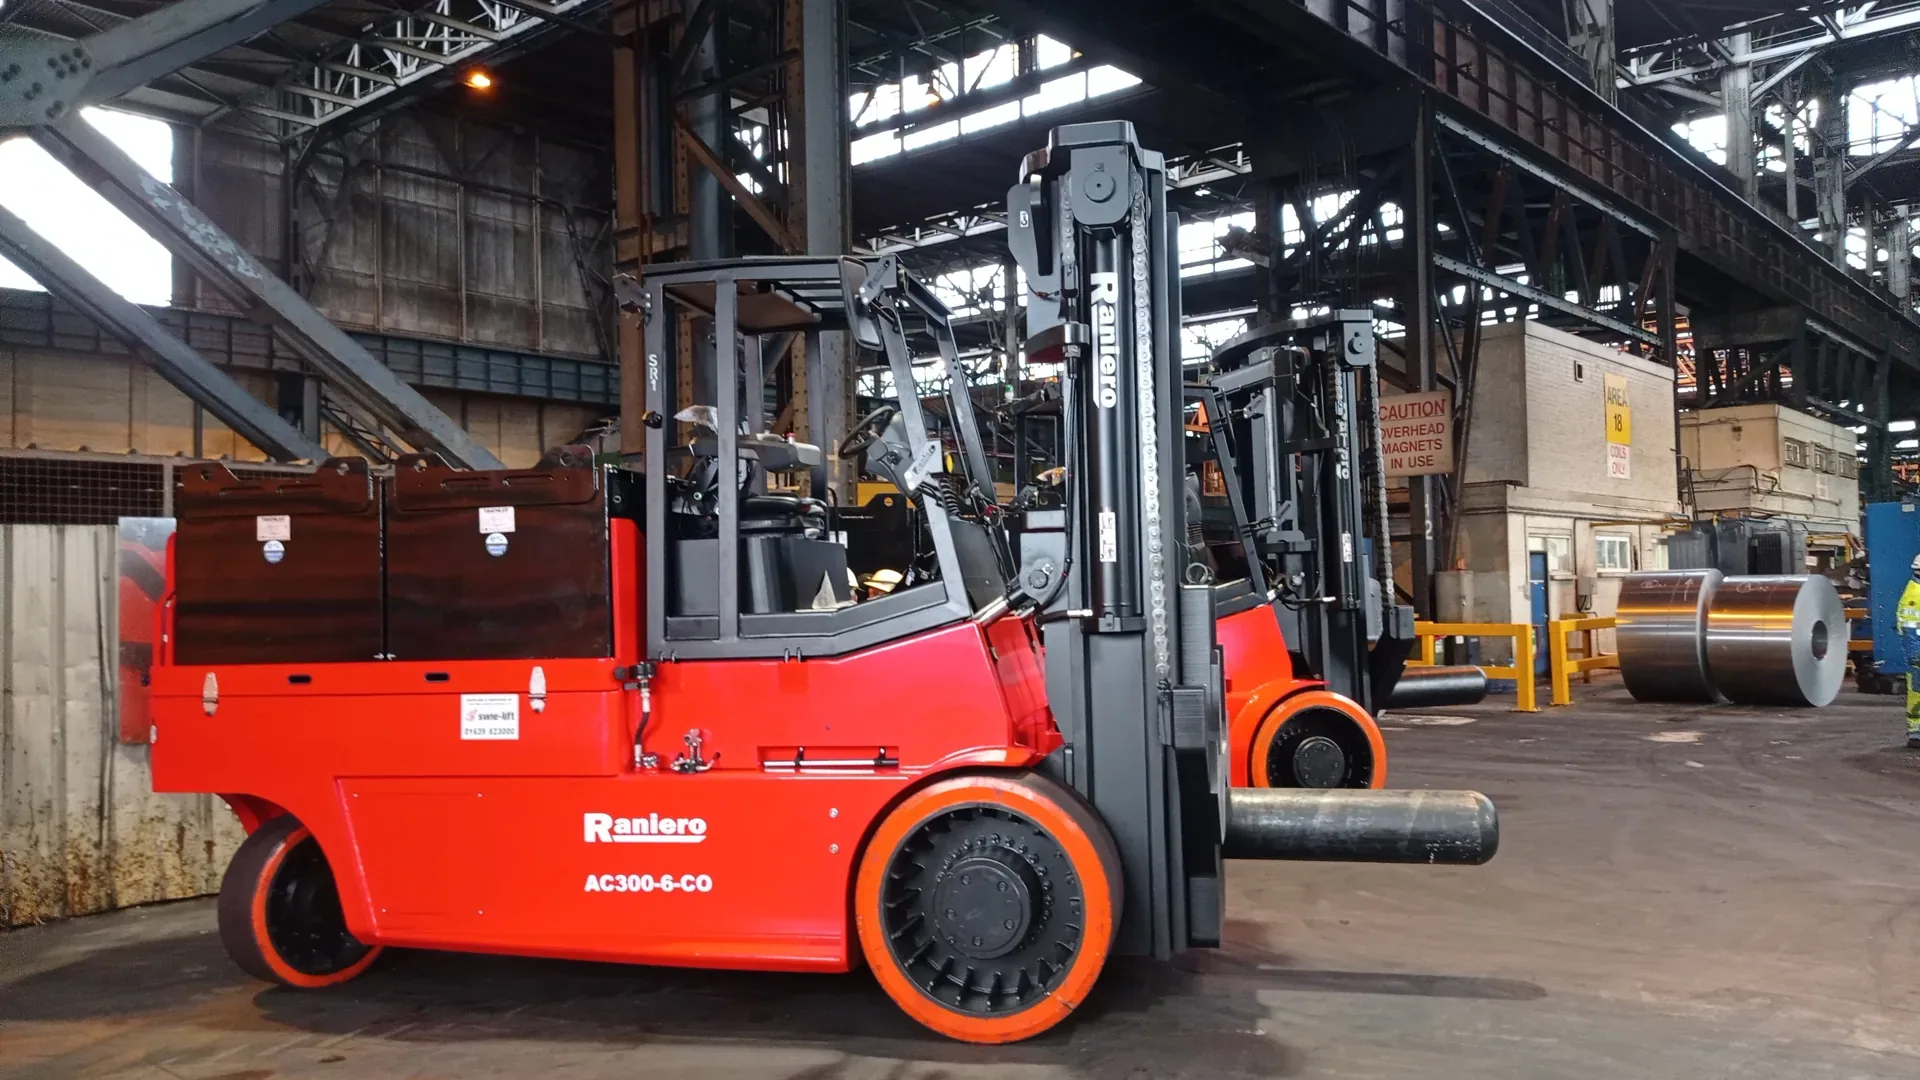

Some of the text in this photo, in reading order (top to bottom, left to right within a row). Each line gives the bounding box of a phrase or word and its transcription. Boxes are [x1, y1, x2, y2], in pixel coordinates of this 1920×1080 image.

[1090, 272, 1120, 408] Raniero
[648, 353, 658, 392] SR1
[1607, 386, 1628, 407] AREA
[1379, 399, 1446, 420] CAUTION
[1613, 413, 1623, 432] 18
[1382, 439, 1442, 455] MAGNETS
[1391, 455, 1434, 469] IN USE
[584, 812, 707, 842] Raniero
[584, 874, 713, 892] AC300-6-CO
